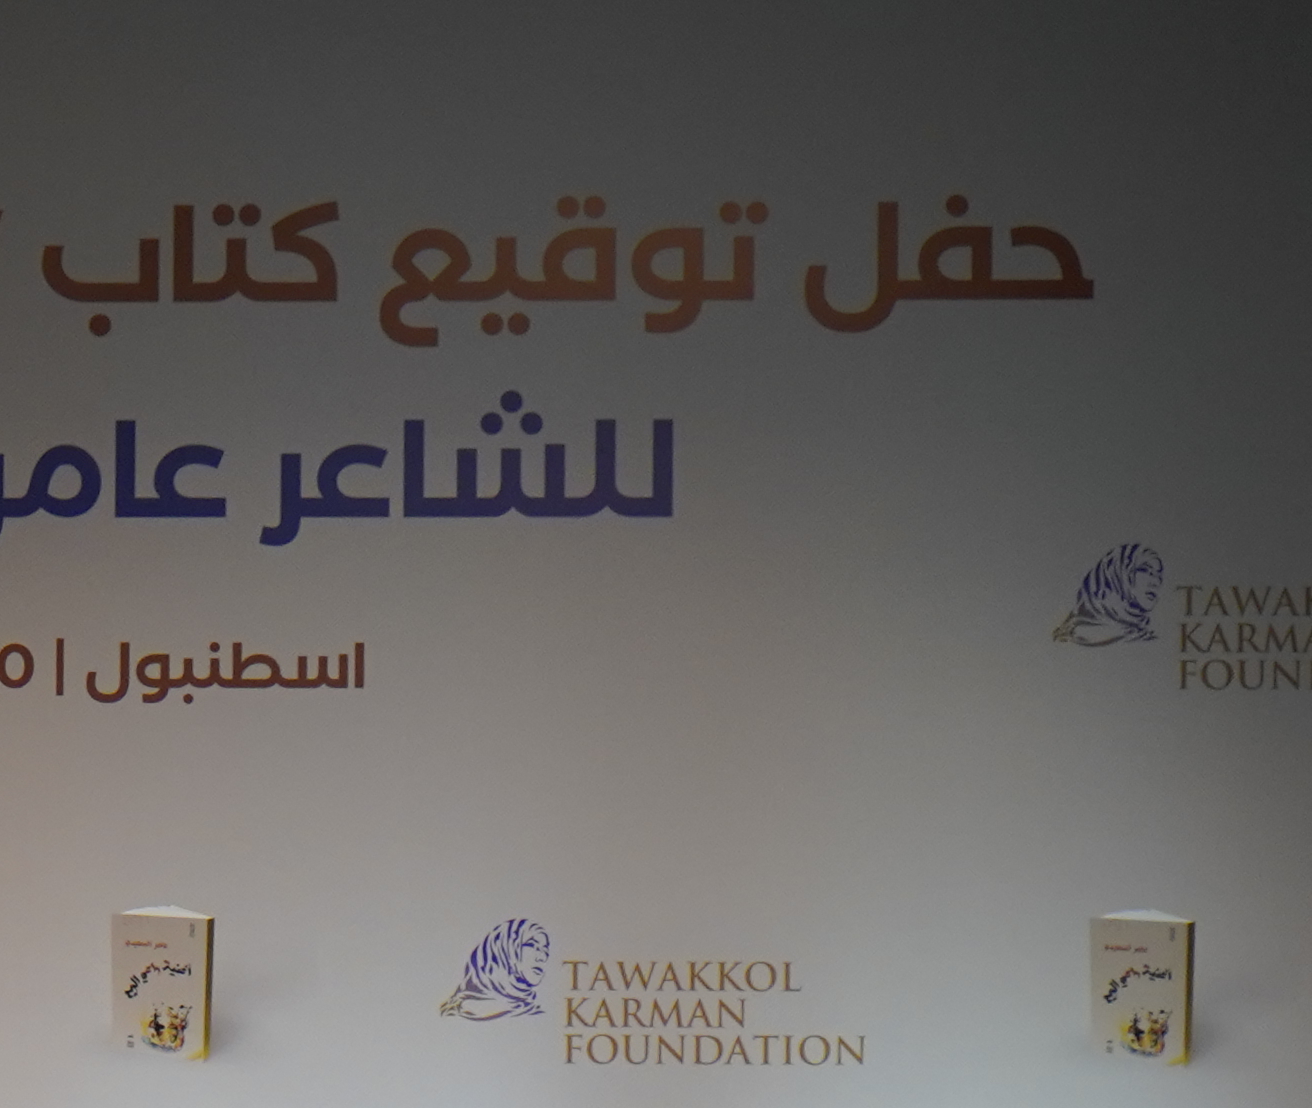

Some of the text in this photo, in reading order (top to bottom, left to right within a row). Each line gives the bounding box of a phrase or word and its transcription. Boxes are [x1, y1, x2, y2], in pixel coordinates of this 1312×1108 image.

[42, 201, 339, 337] كتاب
[379, 196, 768, 348] توقيع
[805, 195, 1094, 333] حفل
[259, 390, 673, 546] للشاعر
[86, 642, 365, 704] اسطنبول
[562, 960, 802, 993] TAWAKKOL
[565, 997, 746, 1029] KARMAN
[565, 1033, 866, 1067] FOUNDATION
